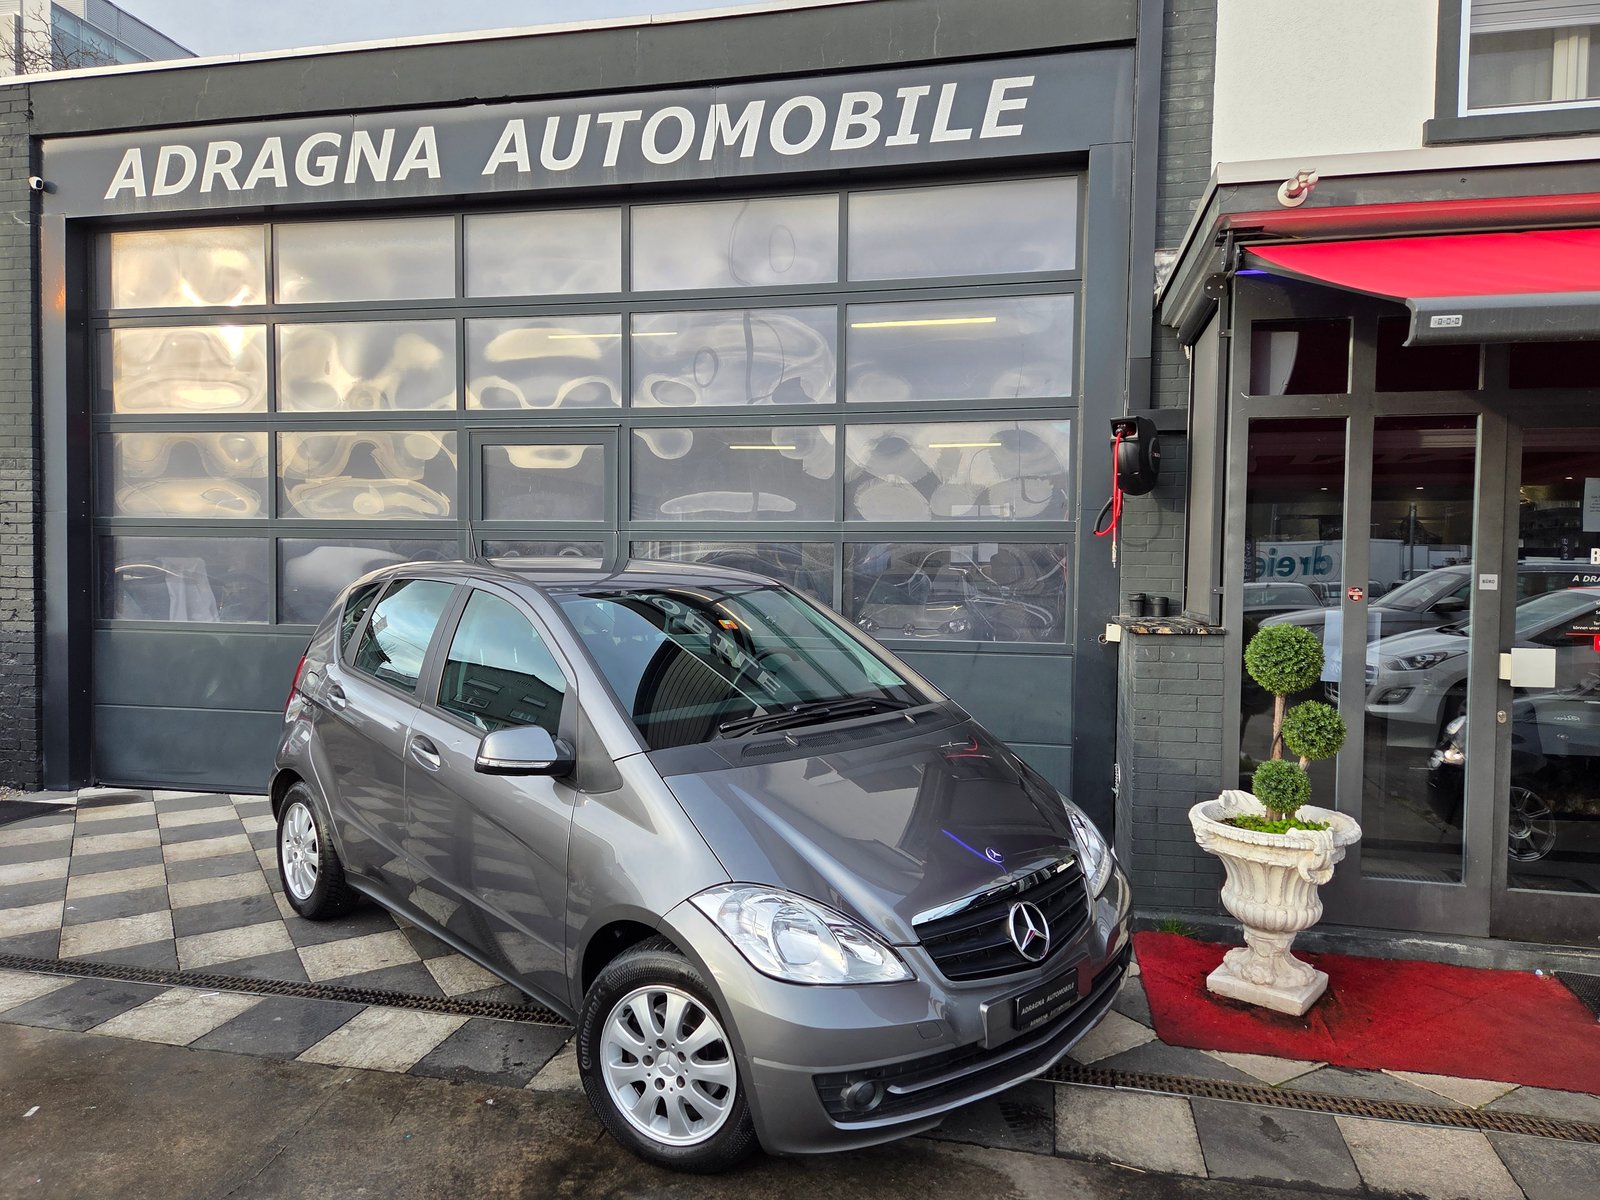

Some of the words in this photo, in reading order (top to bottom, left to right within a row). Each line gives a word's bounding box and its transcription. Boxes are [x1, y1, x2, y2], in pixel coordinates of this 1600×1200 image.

[104, 126, 441, 200] ADRAGNA
[481, 75, 1035, 176] AUTOMOBILE
[581, 994, 602, 1070] Continental
